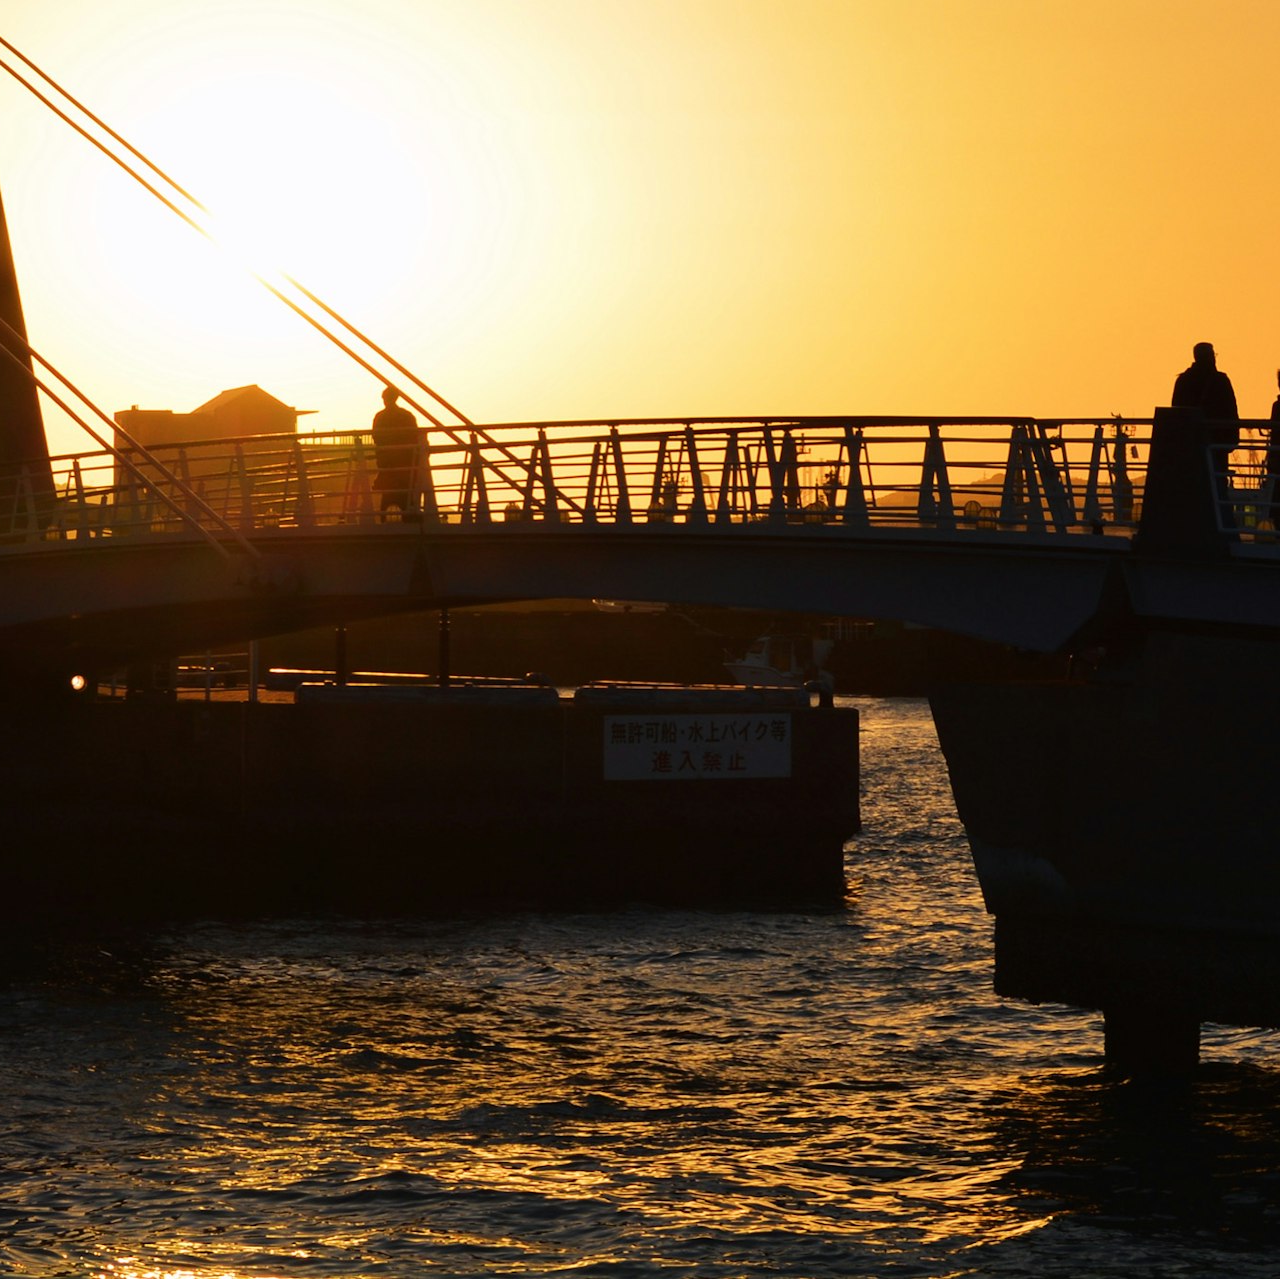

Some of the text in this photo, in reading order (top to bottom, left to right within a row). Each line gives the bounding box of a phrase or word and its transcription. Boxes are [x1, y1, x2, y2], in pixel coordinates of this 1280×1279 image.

[610, 719, 787, 744] 無許可船・水上バイク等
[651, 750, 747, 773] 進入禁止
